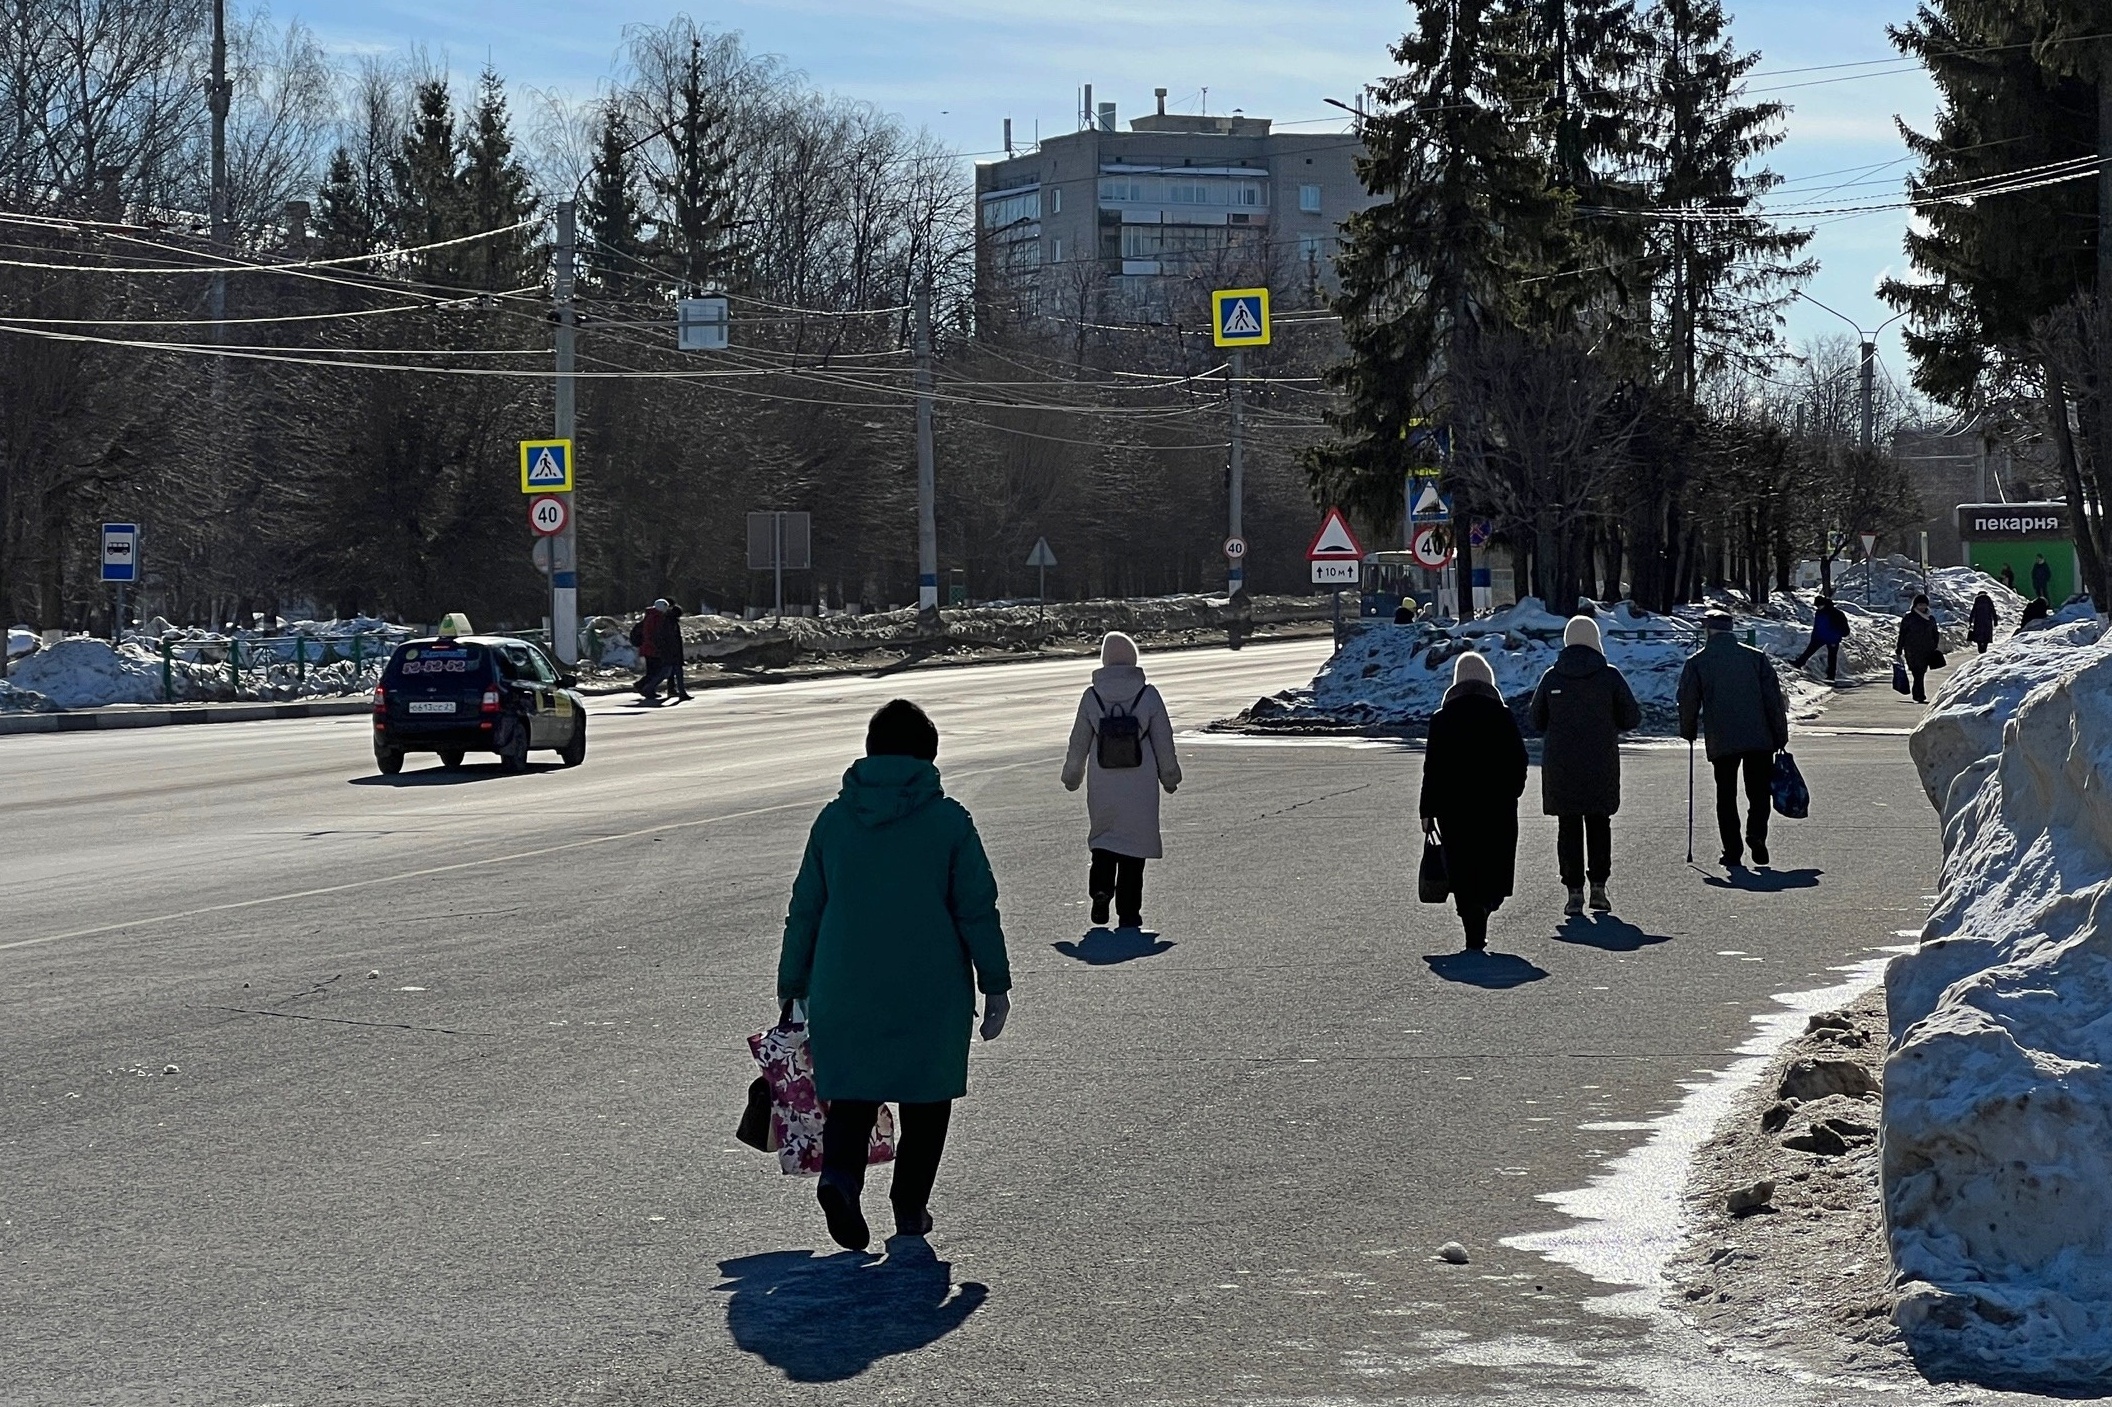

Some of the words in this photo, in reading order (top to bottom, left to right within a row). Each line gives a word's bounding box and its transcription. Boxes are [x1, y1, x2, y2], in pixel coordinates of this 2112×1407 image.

[538, 506, 557, 523] 40
[1975, 517, 2059, 534] пекарня
[1227, 543, 1242, 553] 40
[1325, 567, 1337, 577] 10
[1338, 569, 1346, 577] м
[402, 660, 466, 675] 52-52-52
